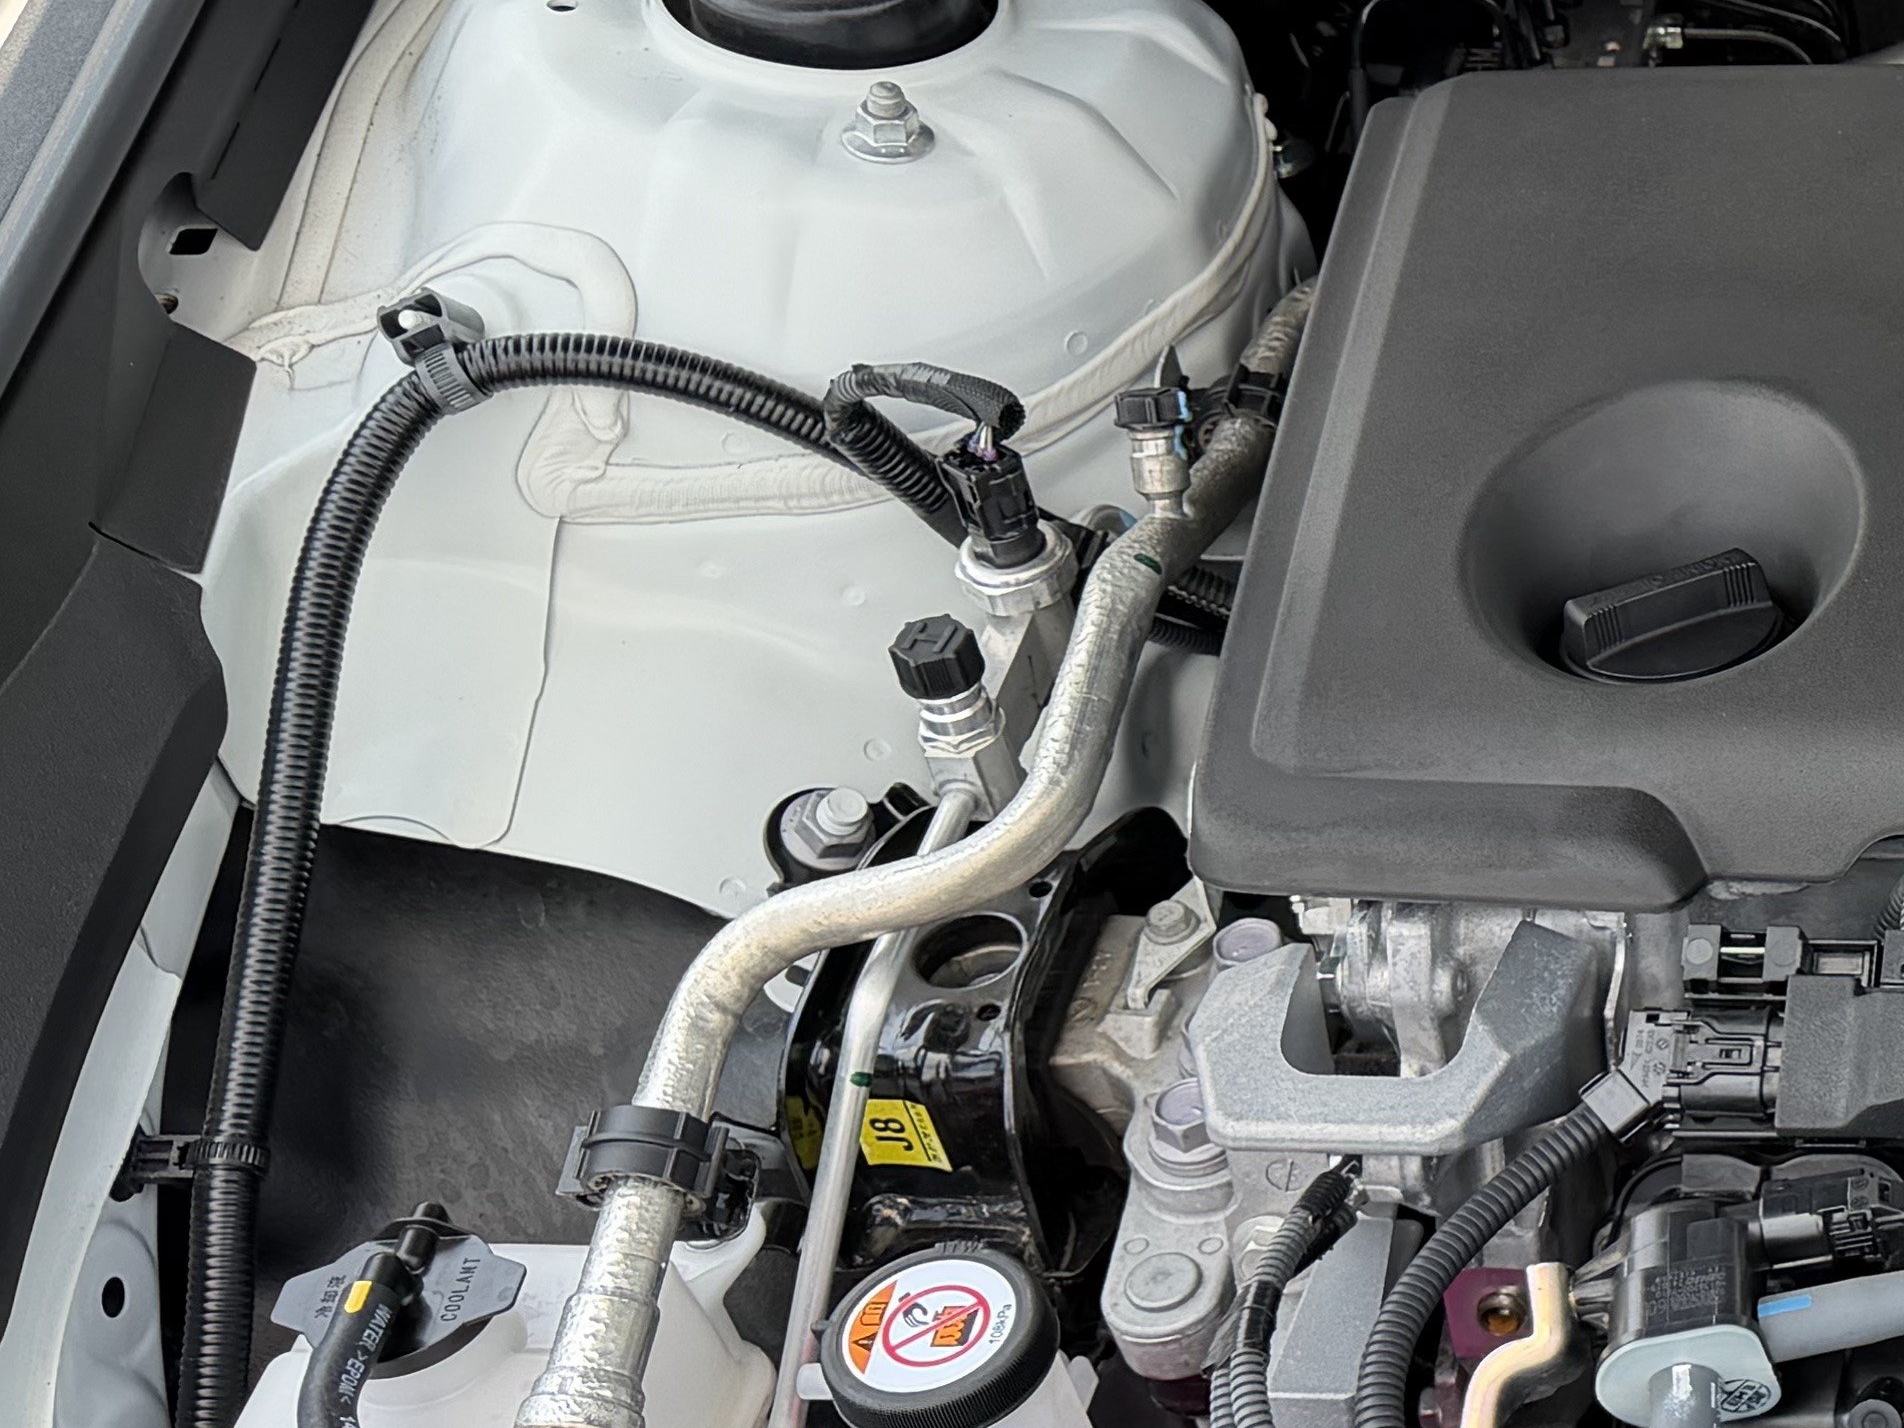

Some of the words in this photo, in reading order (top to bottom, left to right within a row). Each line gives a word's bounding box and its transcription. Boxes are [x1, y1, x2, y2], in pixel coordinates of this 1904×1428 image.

[869, 1117, 914, 1152] J8
[440, 1256, 482, 1323] COOLANT
[361, 1303, 392, 1352] WATER
